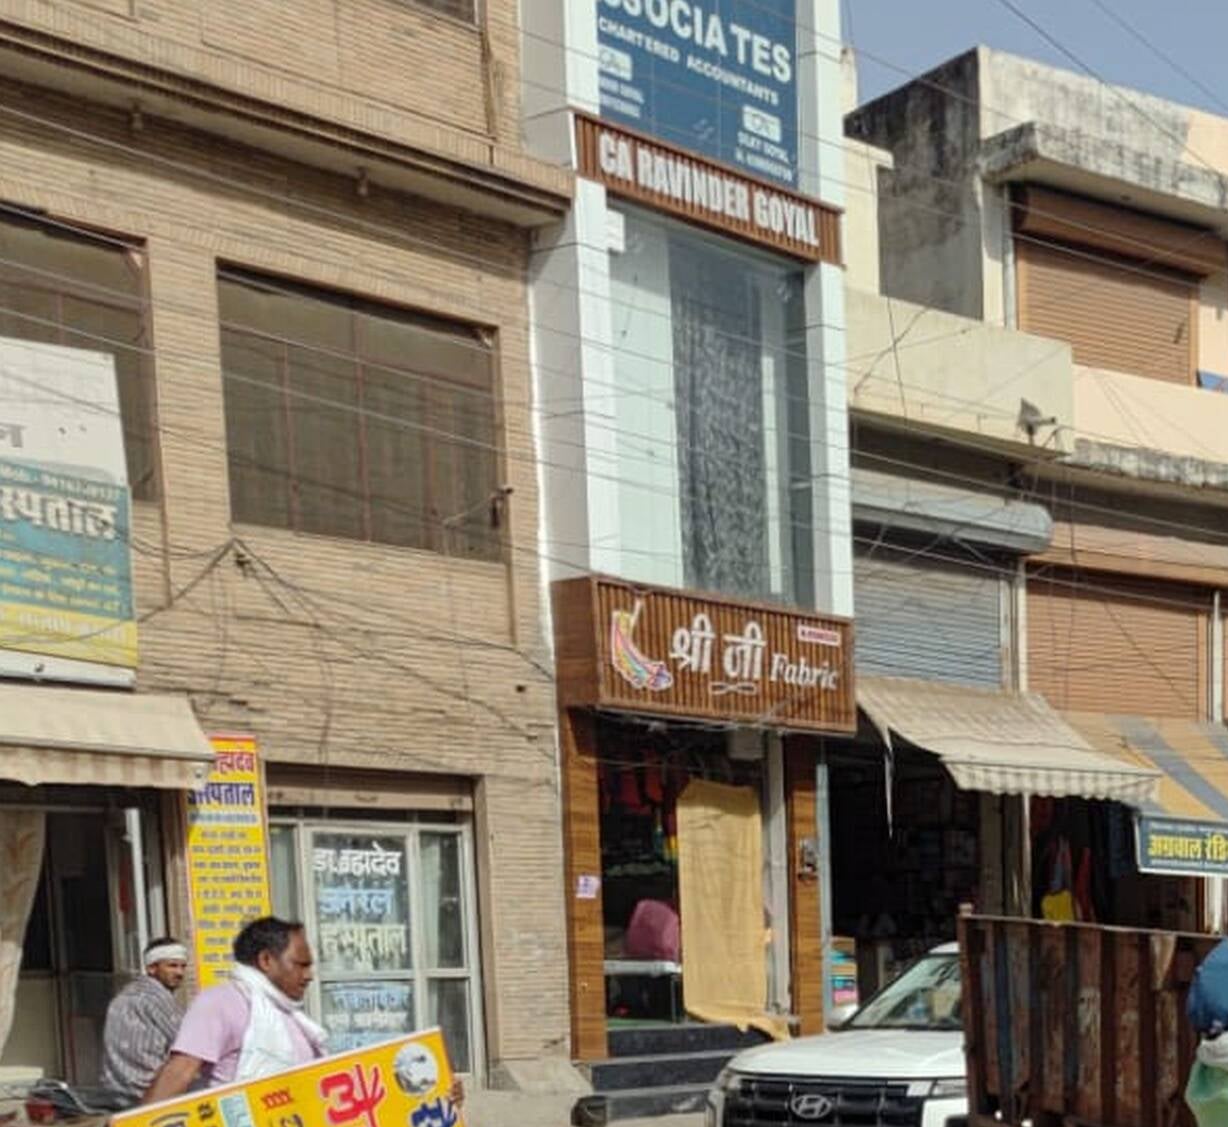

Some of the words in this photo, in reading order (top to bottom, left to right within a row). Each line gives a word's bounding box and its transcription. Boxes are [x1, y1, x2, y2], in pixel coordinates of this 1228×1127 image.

[599, 15, 680, 62] CHARTERED
[637, 143, 749, 219] RAVINDER
[753, 188, 820, 246] GOYAL
[770, 652, 838, 691] Fabric
